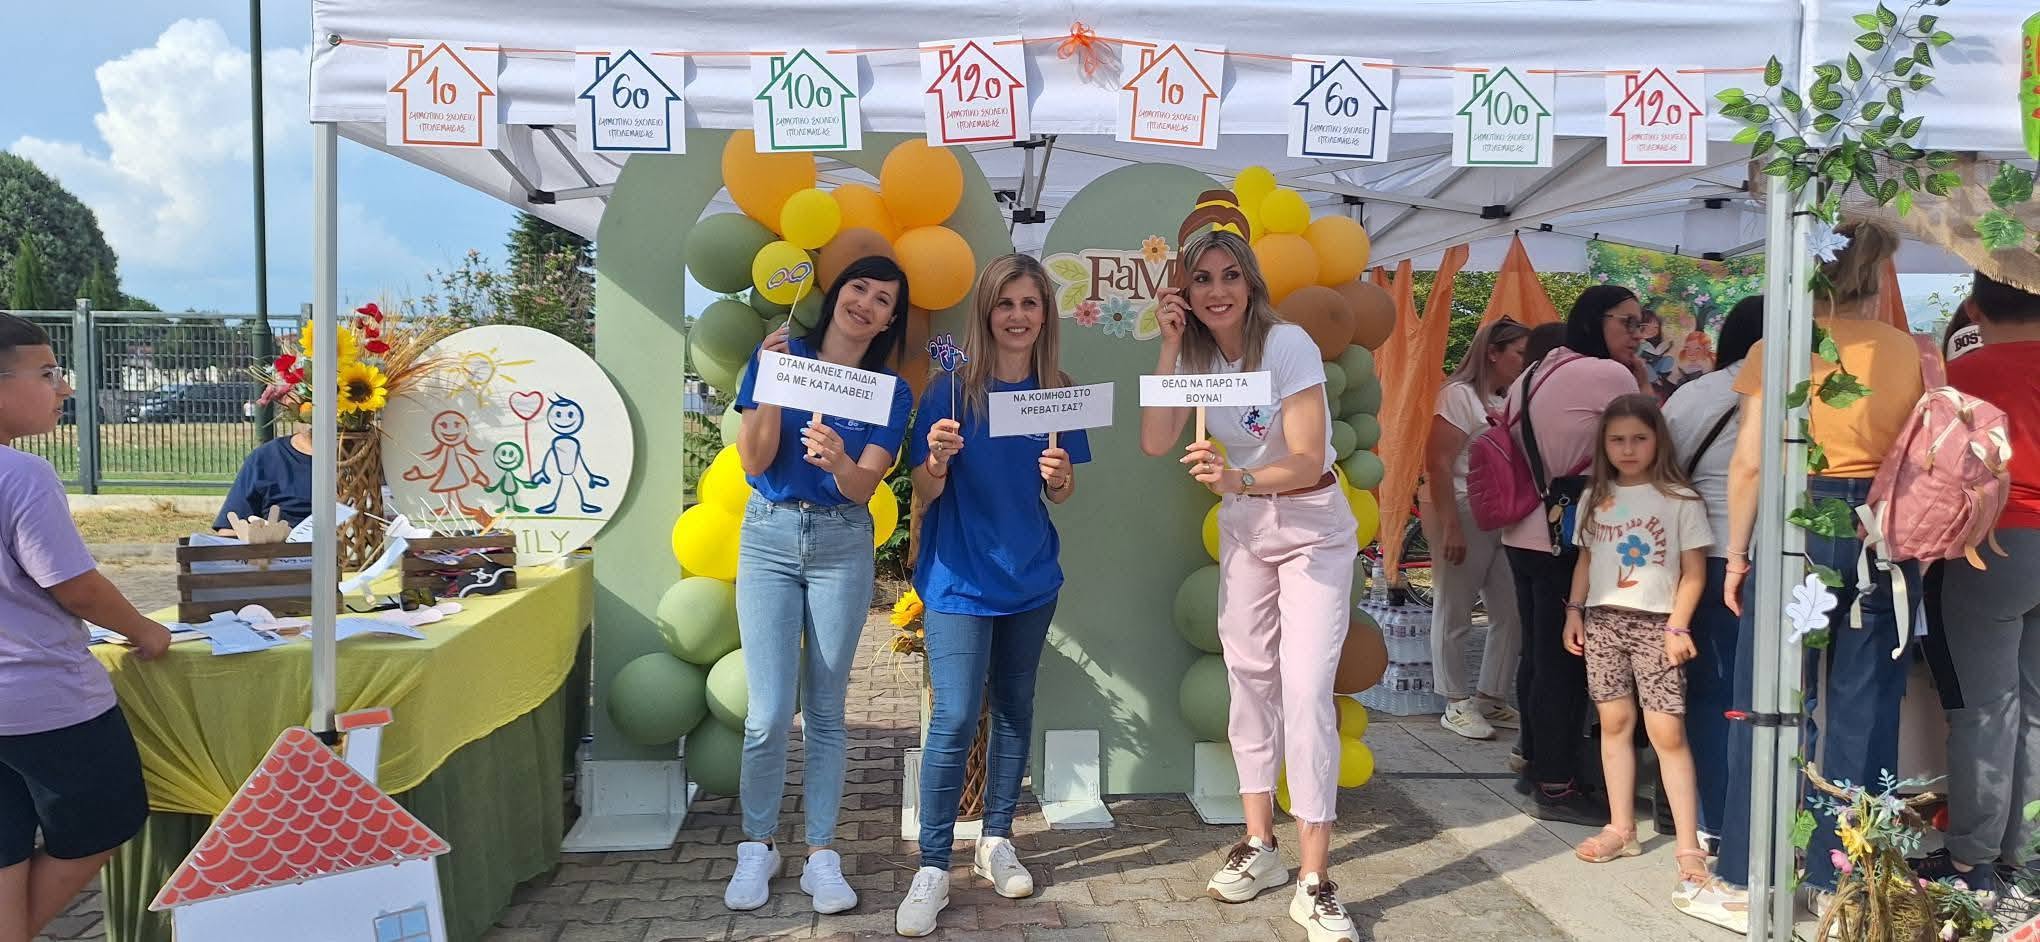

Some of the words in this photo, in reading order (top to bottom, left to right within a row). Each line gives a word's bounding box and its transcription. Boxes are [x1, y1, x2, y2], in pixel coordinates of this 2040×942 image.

[778, 357, 805, 370] ΟΤΑΝ
[807, 361, 843, 378] ΚΑΝΕΙΣ
[845, 370, 877, 386] ΠΑΙΔΙΑ
[776, 372, 790, 383] ΘΑ
[792, 376, 807, 386] ΜΕ
[809, 378, 874, 400] ΚΑΤΑΛΑΒΕΙΣ!
[1162, 379, 1187, 388] ΘΕΛΩ
[1190, 379, 1203, 388] ΝΑ
[1205, 378, 1233, 388] ΠΑΡΩ
[1236, 378, 1248, 387] ΤΑ
[1013, 393, 1027, 402] ΝΑ
[1029, 391, 1071, 401] ΚΟΙΜΗΘΩ
[1073, 388, 1091, 398] ΣΤΟ
[1186, 394, 1222, 403] ΒΟΥΝΑ!
[1021, 404, 1060, 415] ΚΡΕΒΑΤΙ
[1061, 402, 1083, 412] ΣΑΣ?
[516, 529, 570, 553] ILY
